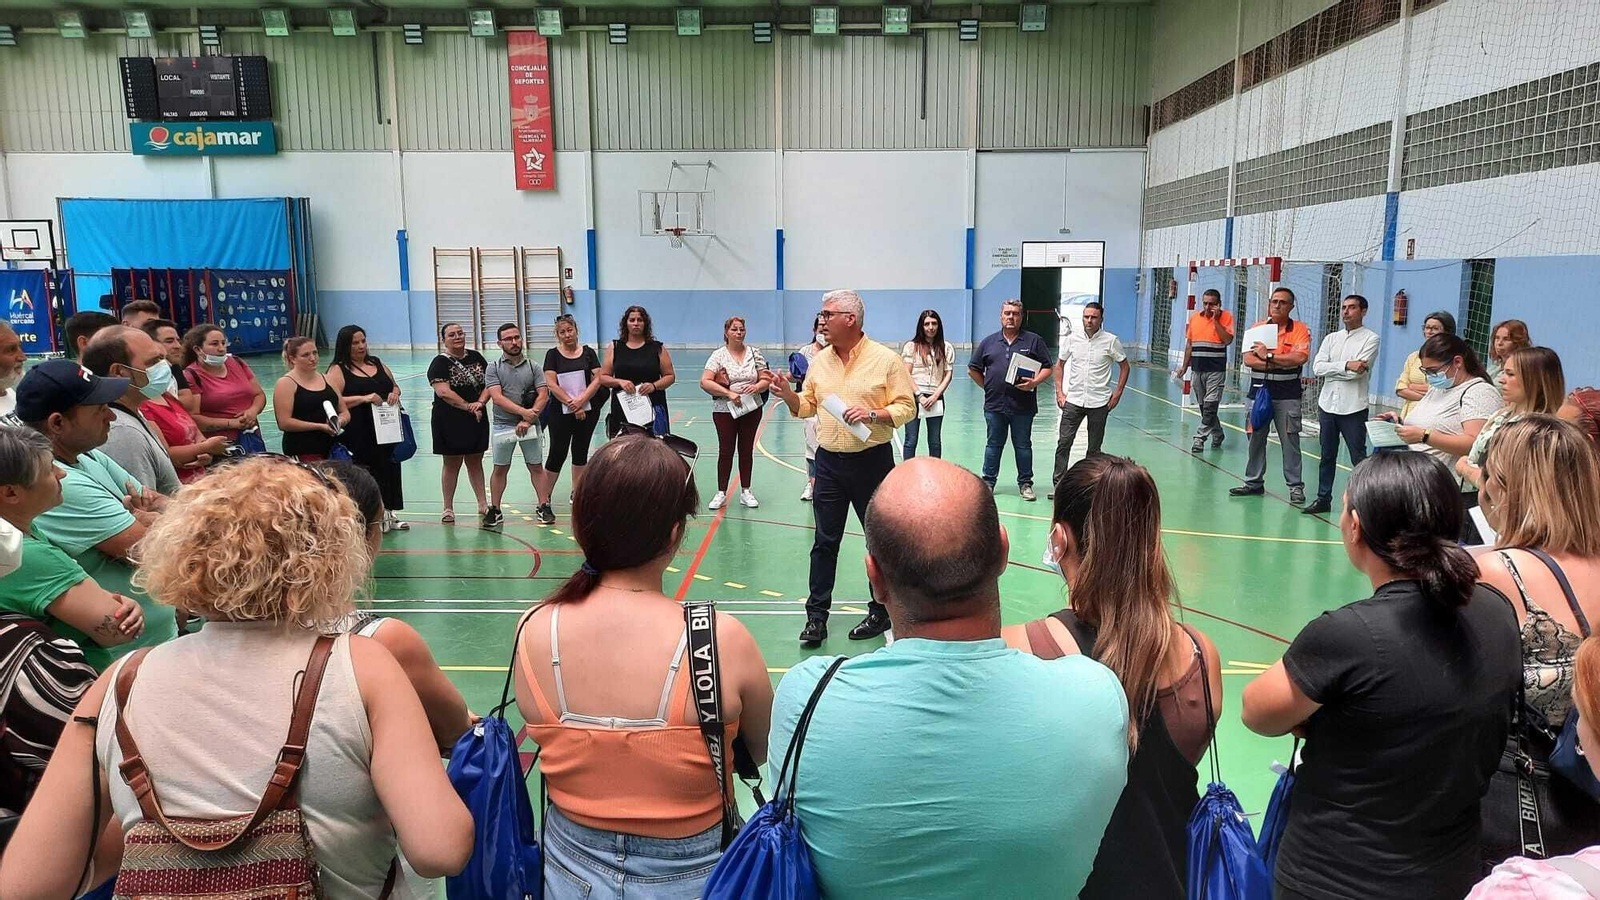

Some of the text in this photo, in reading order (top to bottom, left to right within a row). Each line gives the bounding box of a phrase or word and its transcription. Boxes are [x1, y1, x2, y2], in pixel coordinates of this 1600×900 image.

[173, 126, 262, 150] cajamar
[20, 332, 37, 342] rte
[693, 643, 715, 704] LOLA
